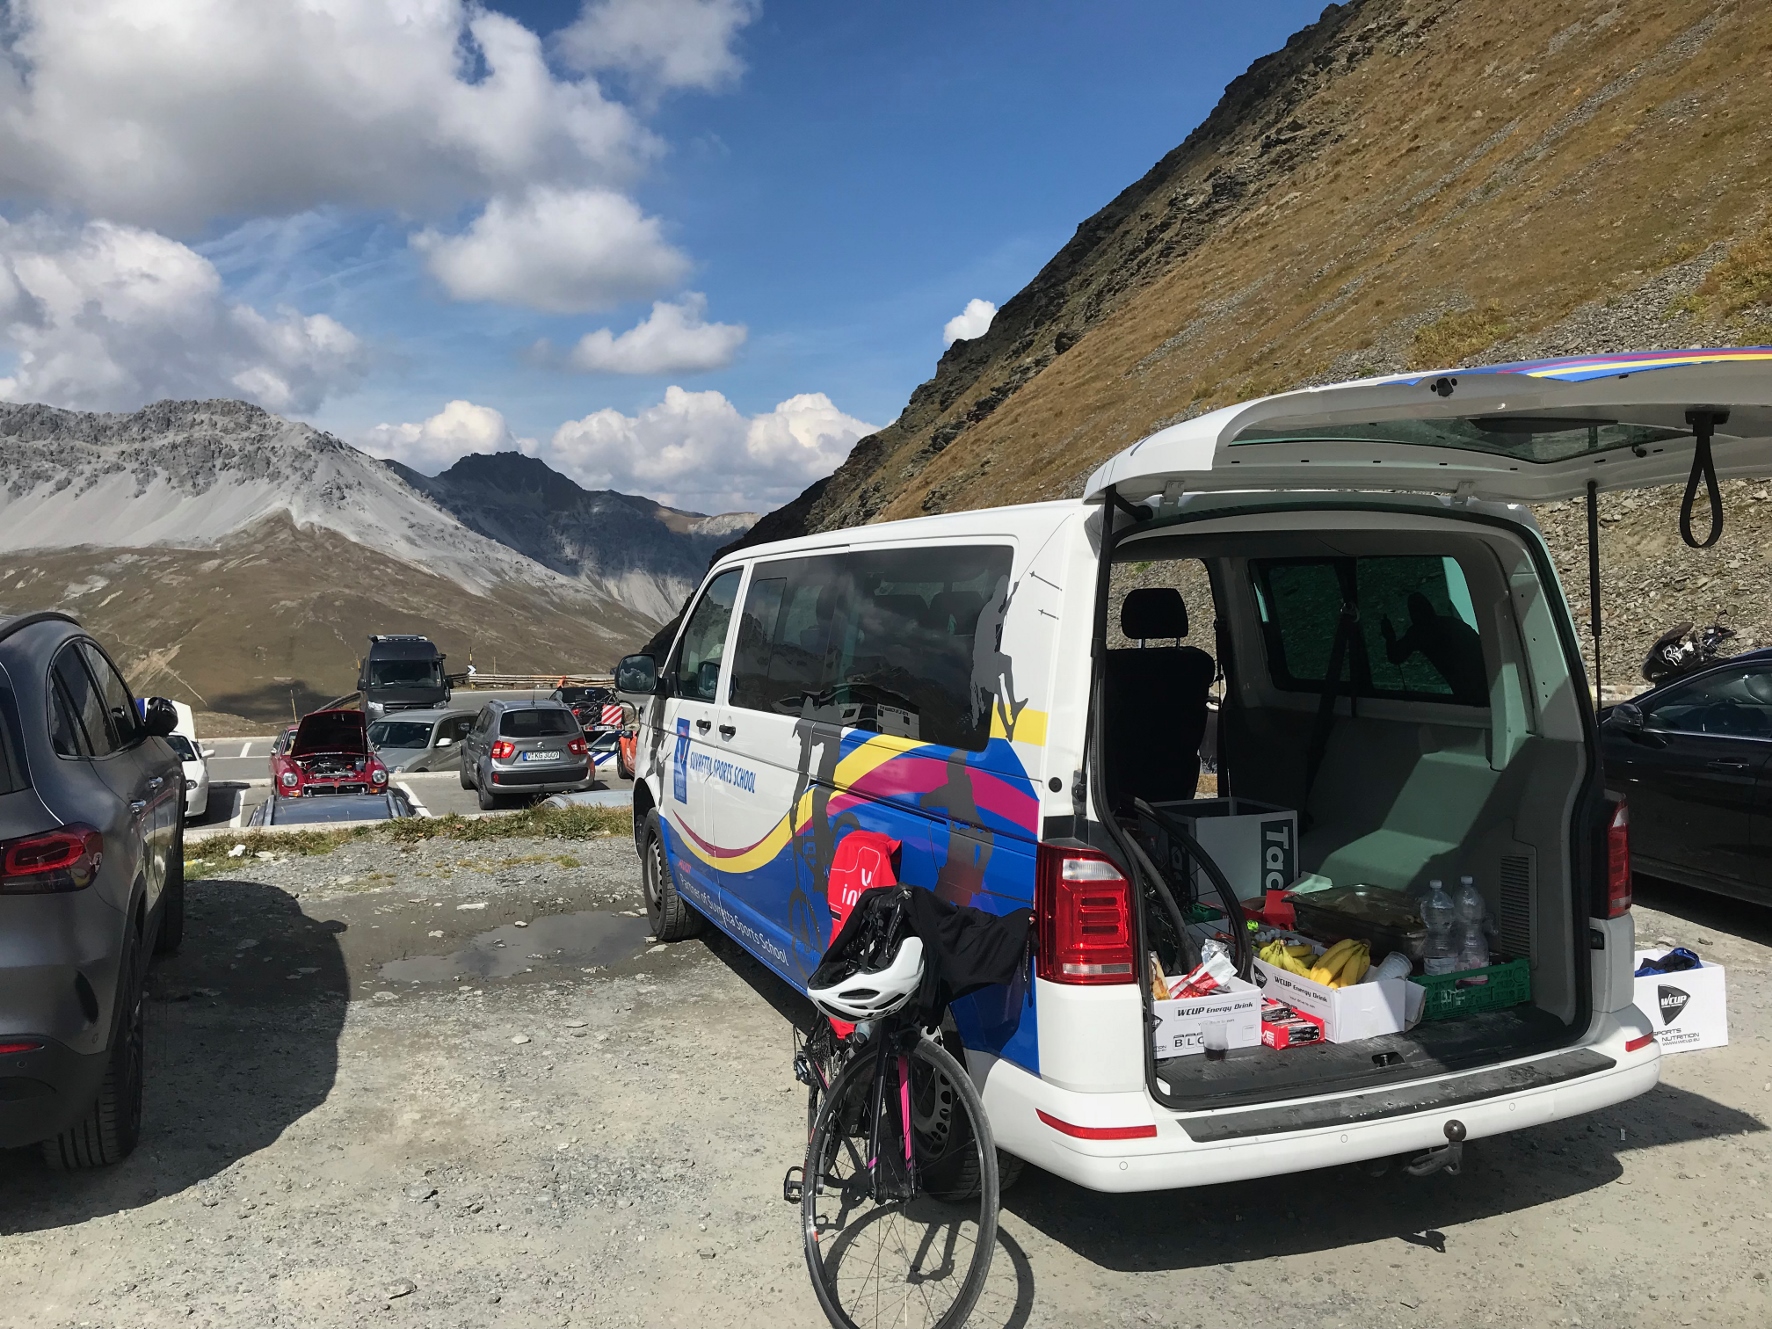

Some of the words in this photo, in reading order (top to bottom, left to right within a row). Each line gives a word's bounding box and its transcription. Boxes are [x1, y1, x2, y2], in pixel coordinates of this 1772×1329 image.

[713, 759, 733, 784] SPORTS
[734, 766, 756, 793] SCHOOL
[1266, 826, 1289, 890] Tac
[680, 873, 700, 899] Partner
[734, 914, 760, 945] Sports
[759, 933, 789, 966] School
[1274, 976, 1292, 988] WCUP
[1292, 984, 1312, 998] Energy
[1312, 992, 1328, 1003] Drink
[1660, 994, 1687, 1006] WCUP
[1177, 1007, 1205, 1017] WCUP
[1206, 1005, 1232, 1014] Energy
[1233, 1002, 1253, 1010] Drink
[1653, 1028, 1682, 1037] SPORTS
[1661, 1033, 1700, 1042] NUTRITION
